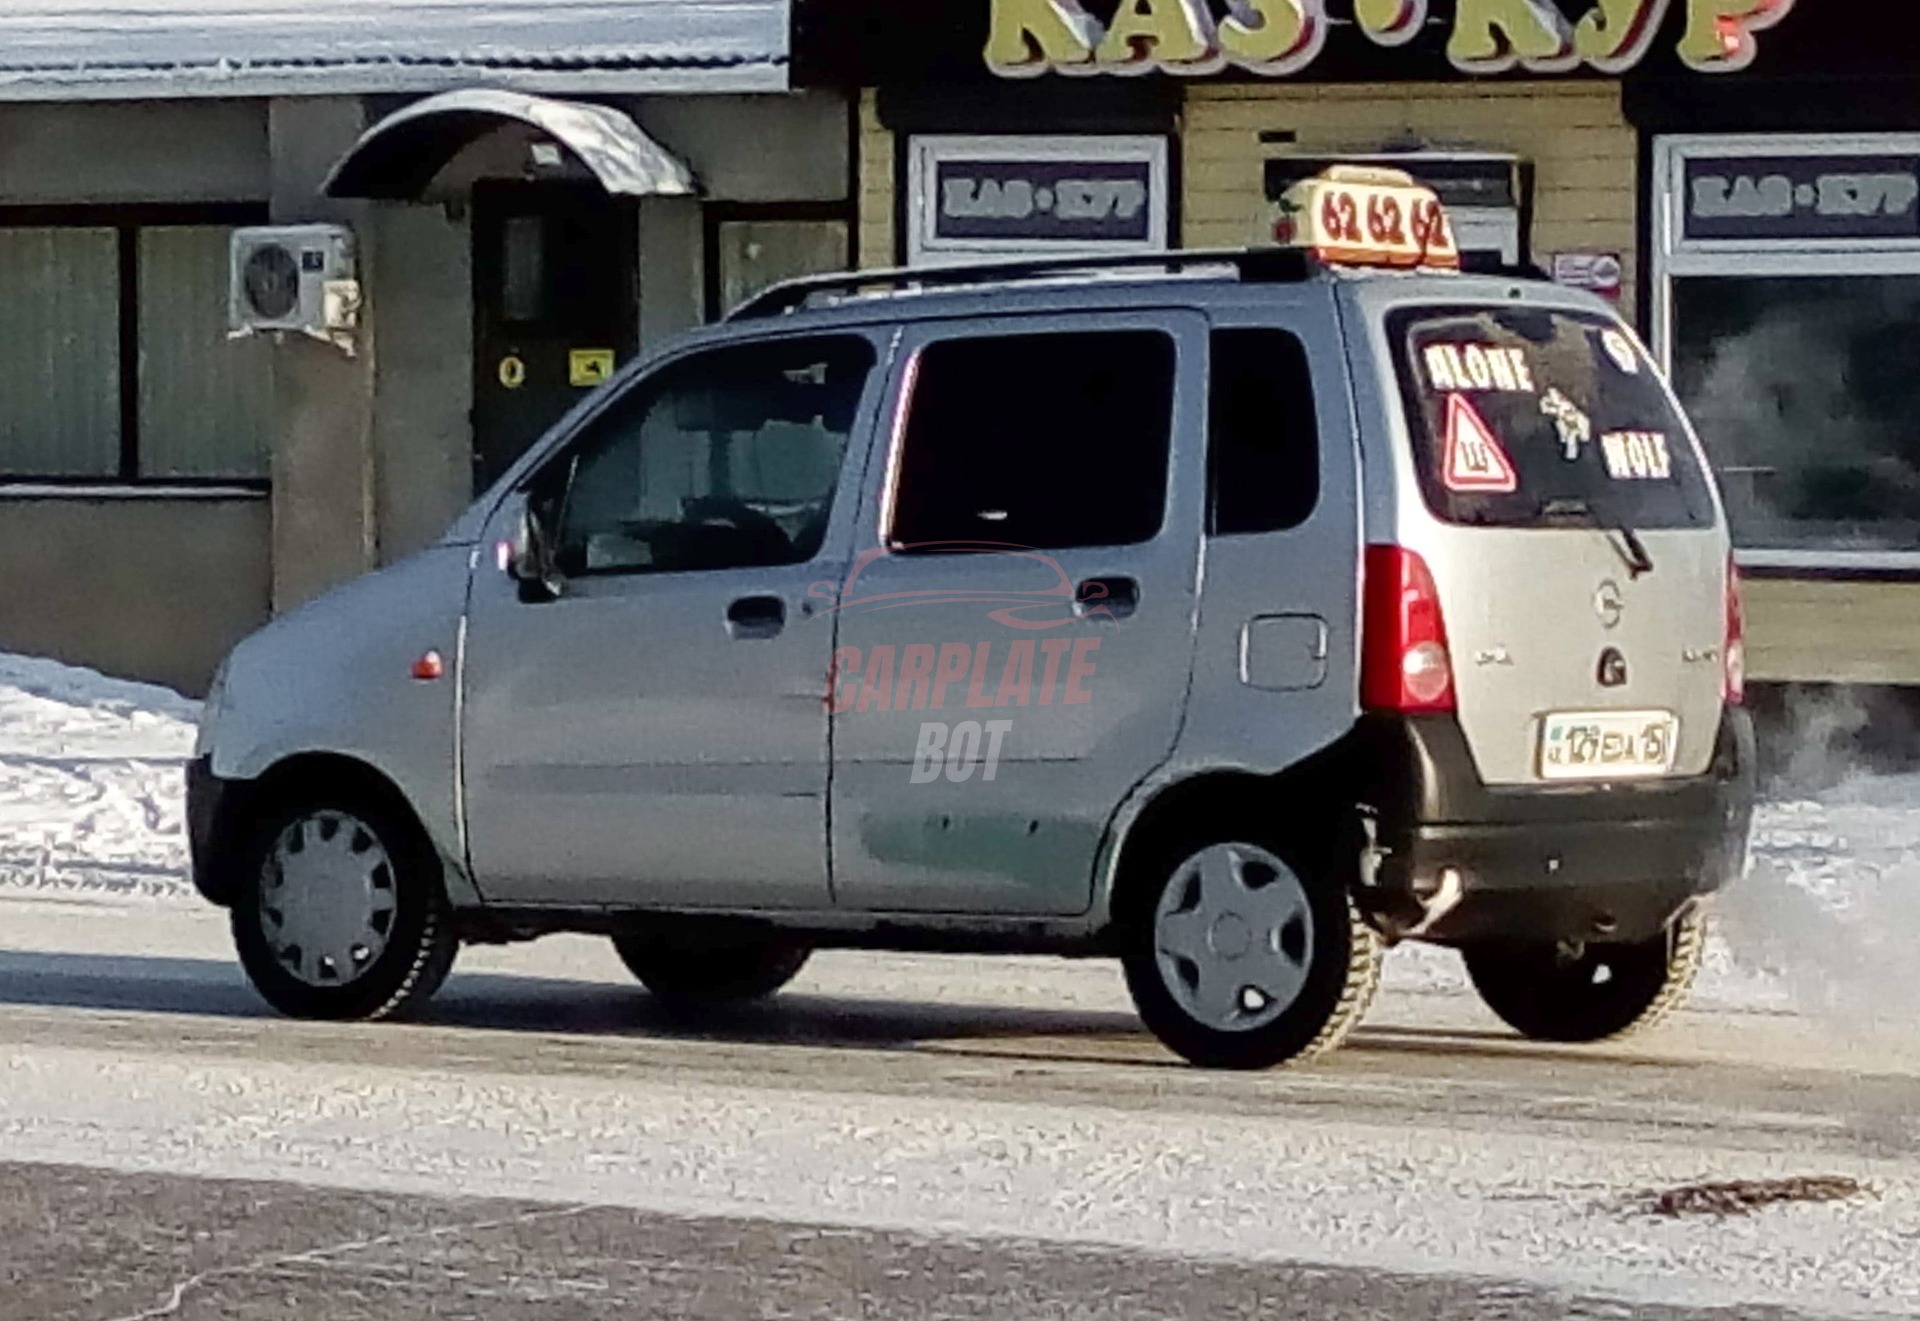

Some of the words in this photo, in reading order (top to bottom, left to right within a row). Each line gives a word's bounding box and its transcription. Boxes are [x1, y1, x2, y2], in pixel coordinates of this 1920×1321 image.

[1320, 191, 1362, 243] 62
[1366, 193, 1405, 245] 62
[1410, 197, 1448, 247] 62
[1423, 344, 1534, 392] ALONE
